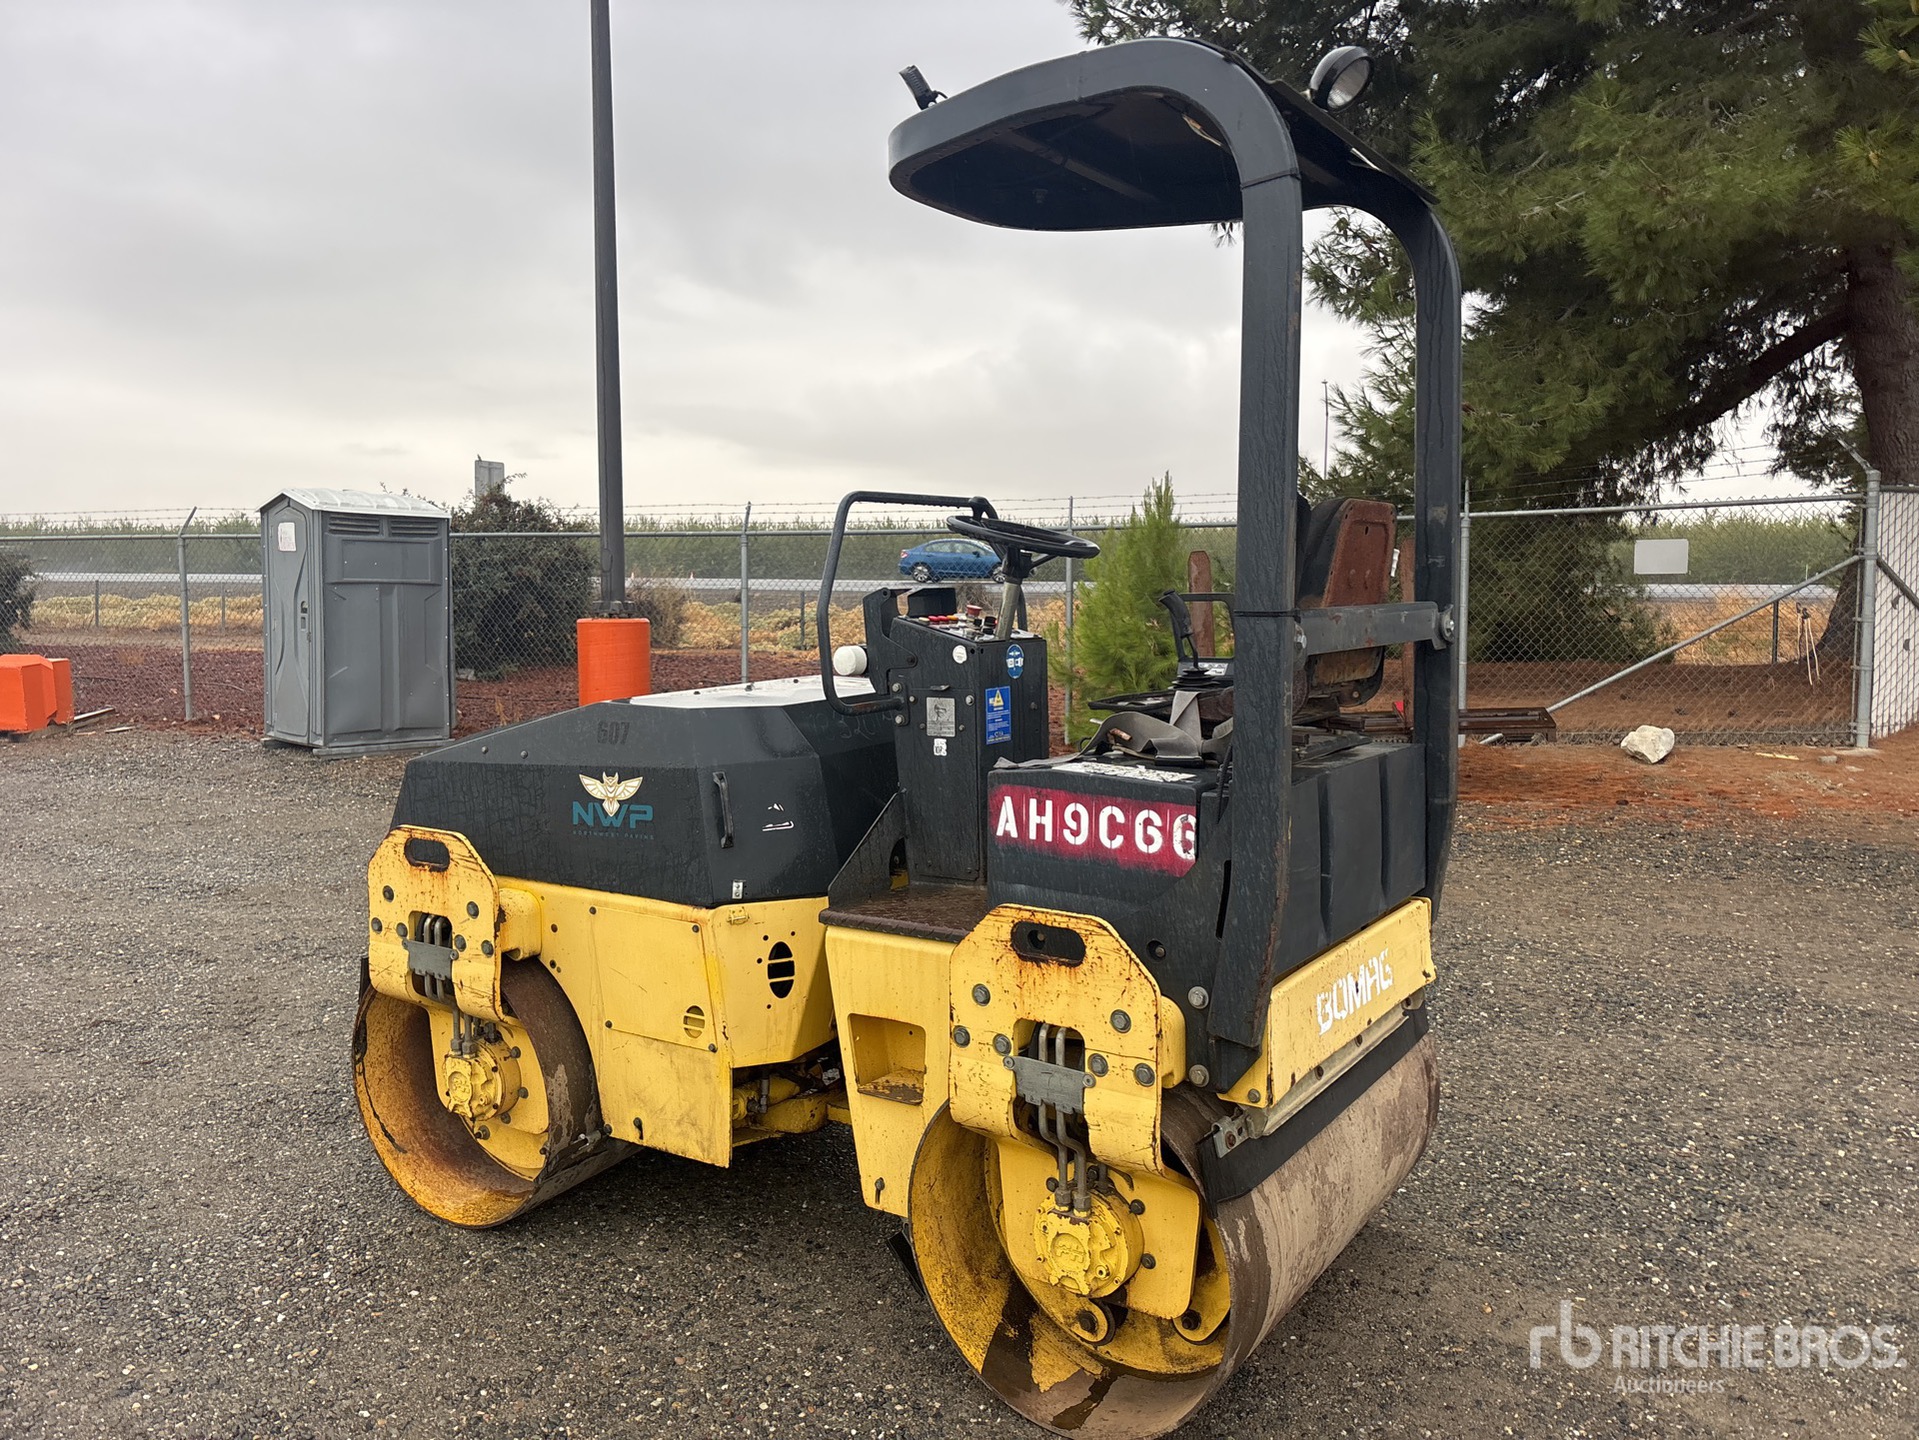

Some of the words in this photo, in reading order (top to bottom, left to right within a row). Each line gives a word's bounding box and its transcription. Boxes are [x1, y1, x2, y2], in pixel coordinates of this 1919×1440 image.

[597, 720, 630, 745] 607
[572, 800, 653, 829] NWP
[996, 795, 1196, 861] AH9C66
[1316, 947, 1393, 1036] BOMAG
